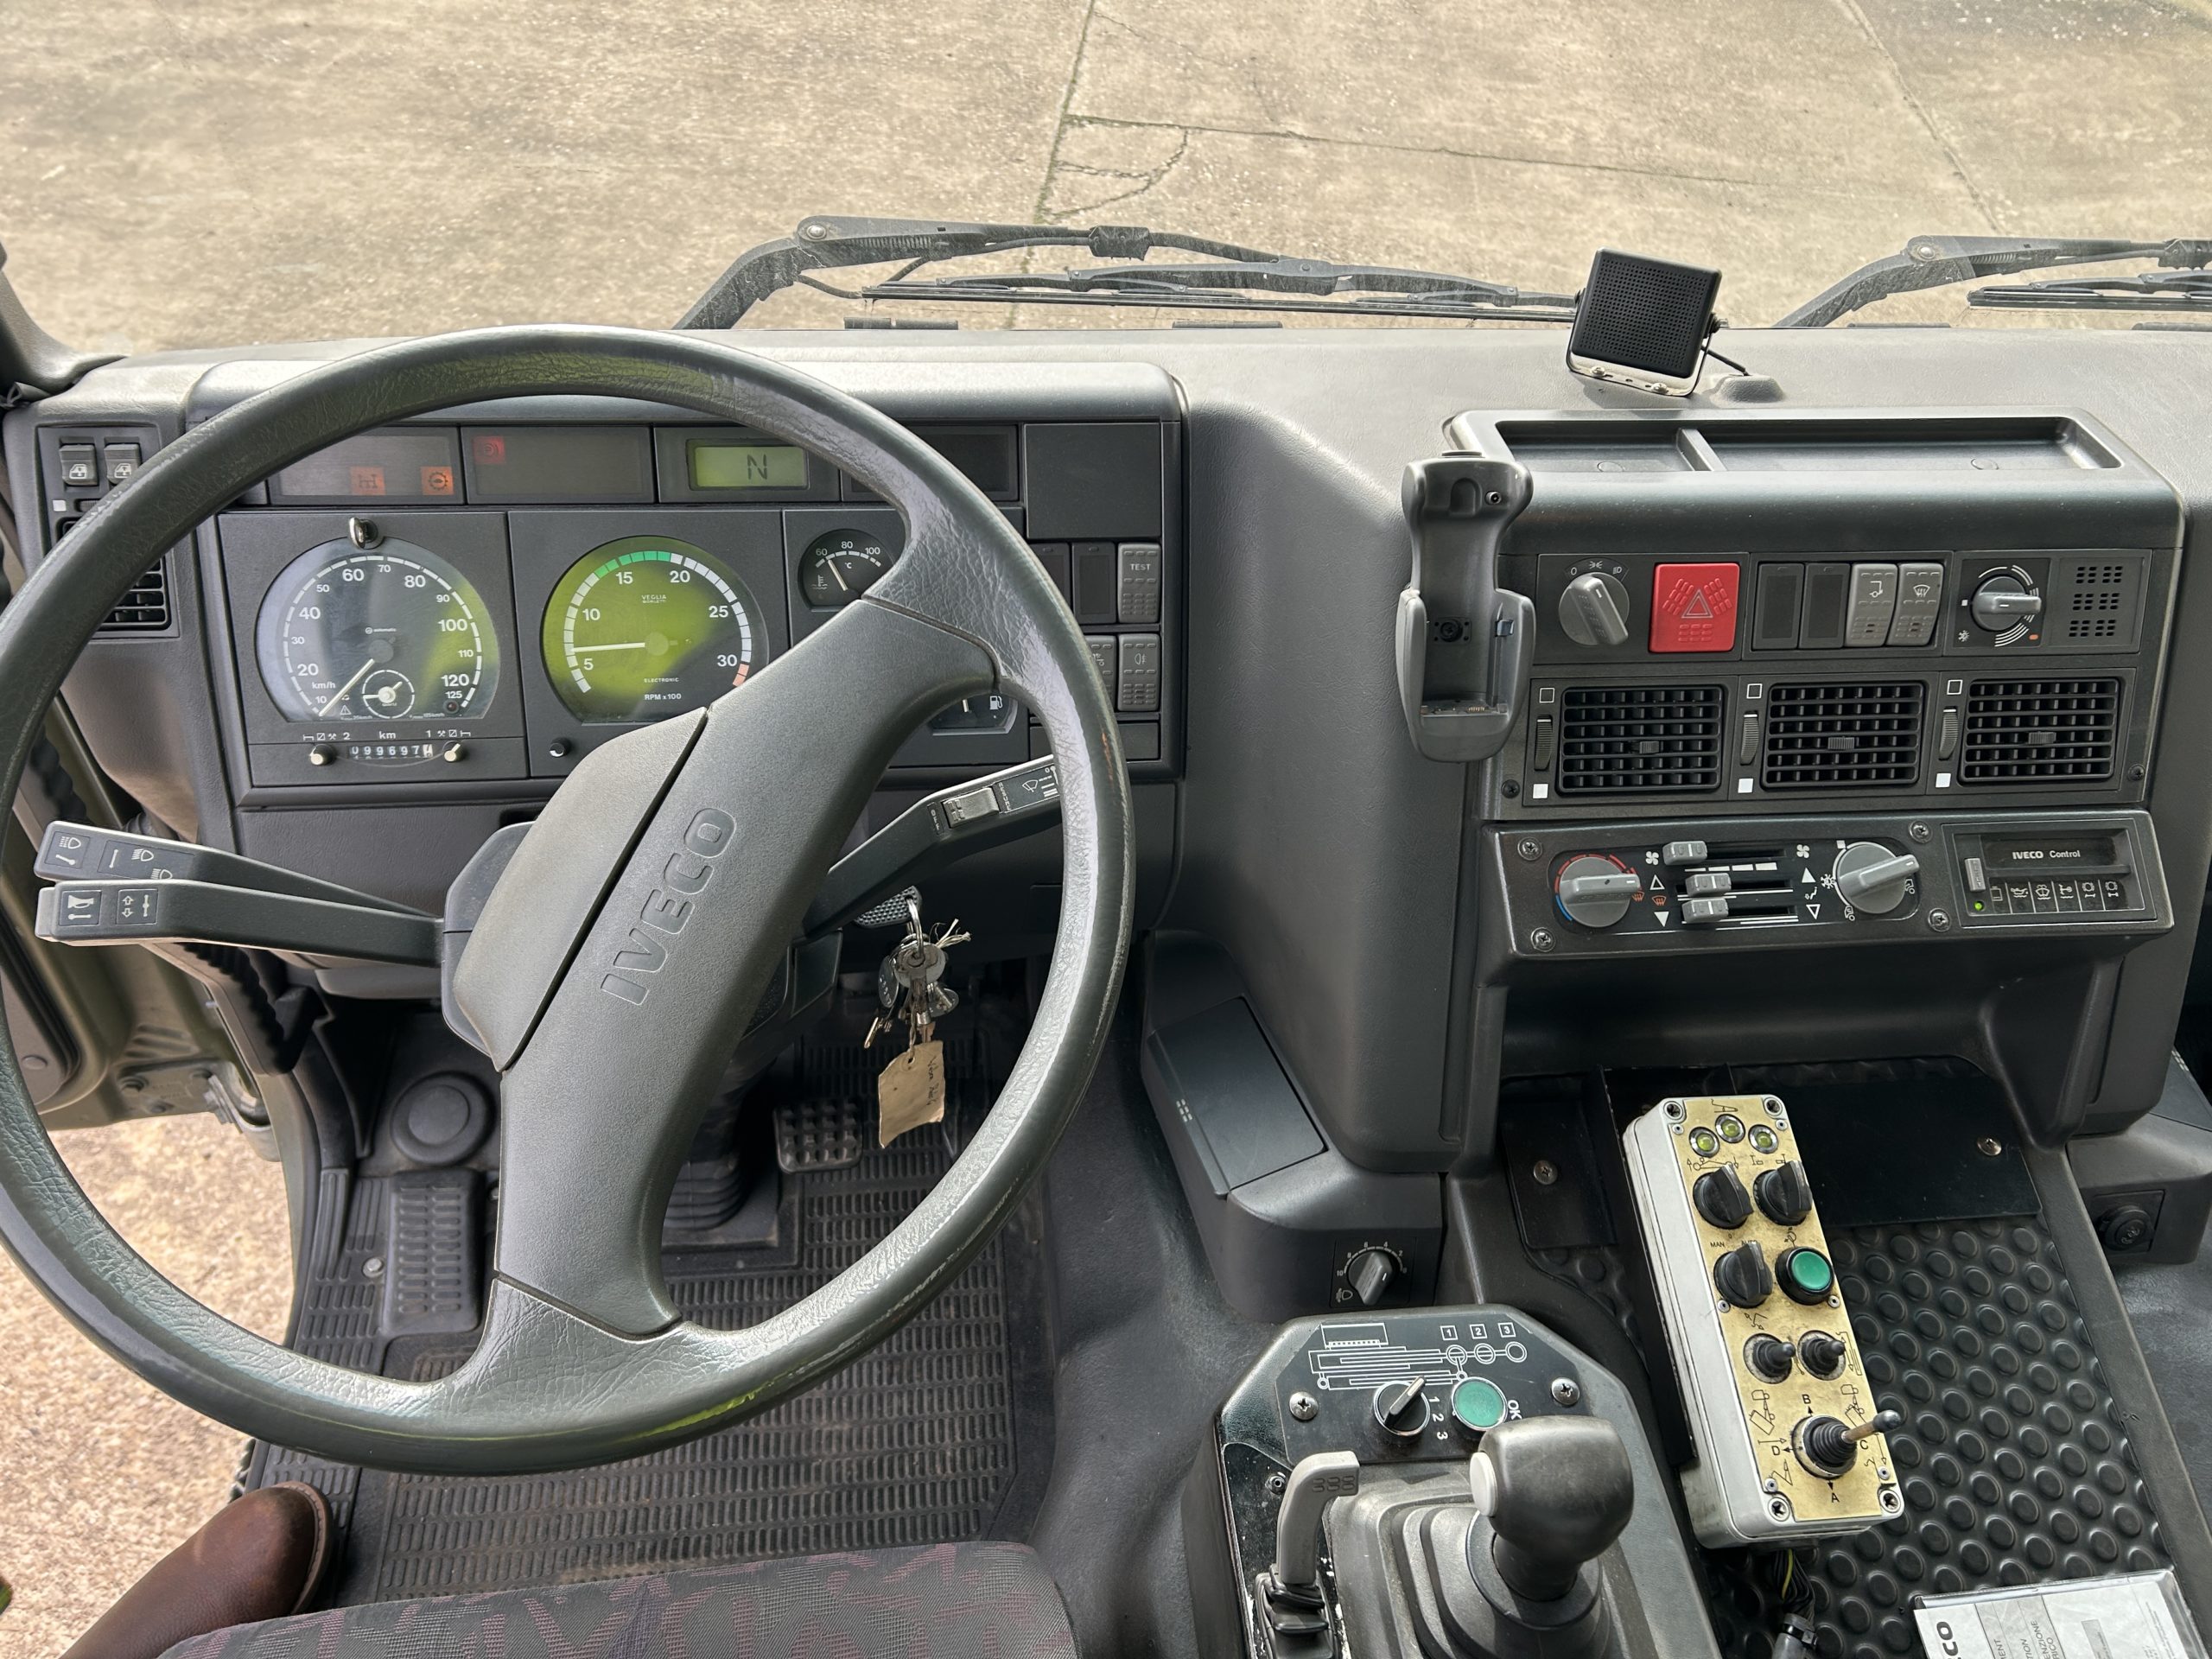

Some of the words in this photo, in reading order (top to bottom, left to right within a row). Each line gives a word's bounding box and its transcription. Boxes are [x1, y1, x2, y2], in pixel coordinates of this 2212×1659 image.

[746, 453, 768, 480] N
[841, 541, 854, 550] 80
[865, 546, 880, 555] 100
[816, 548, 828, 556] 60
[378, 564, 391, 573] 70
[1129, 563, 1151, 571] TEST
[342, 568, 365, 582] 60
[615, 571, 633, 585] 15
[669, 570, 691, 584] 20
[404, 575, 426, 588] 80
[316, 584, 330, 593] 50
[436, 594, 450, 603] 90
[299, 606, 321, 620] 40
[582, 607, 601, 621] 10
[709, 605, 729, 619] 25
[438, 618, 468, 632] 100
[291, 636, 305, 645] 30
[458, 649, 474, 658] 110
[583, 658, 594, 671] 5
[716, 654, 738, 667] 30
[296, 663, 319, 676] 20
[312, 681, 336, 690] km/h
[441, 673, 470, 687] 120
[315, 695, 327, 704] 10
[445, 690, 463, 699] 125
[343, 732, 351, 741] 2
[378, 730, 397, 740] km
[931, 809, 940, 830] OFF
[2012, 850, 2044, 860] IVECO
[2049, 849, 2082, 858] Control
[600, 807, 737, 1006] IVECO
[1446, 1328, 1452, 1338] 1
[1475, 1327, 1482, 1336] 2
[1503, 1325, 1511, 1334] 3
[1802, 1394, 1811, 1405] B
[1507, 1399, 1522, 1421] OK
[1432, 1413, 1445, 1422] 2
[1436, 1431, 1449, 1440] 3
[1771, 1445, 1781, 1456] D
[1859, 1440, 1869, 1451] C
[1830, 1492, 1840, 1503] A
[1936, 1621, 1961, 1659] CO
